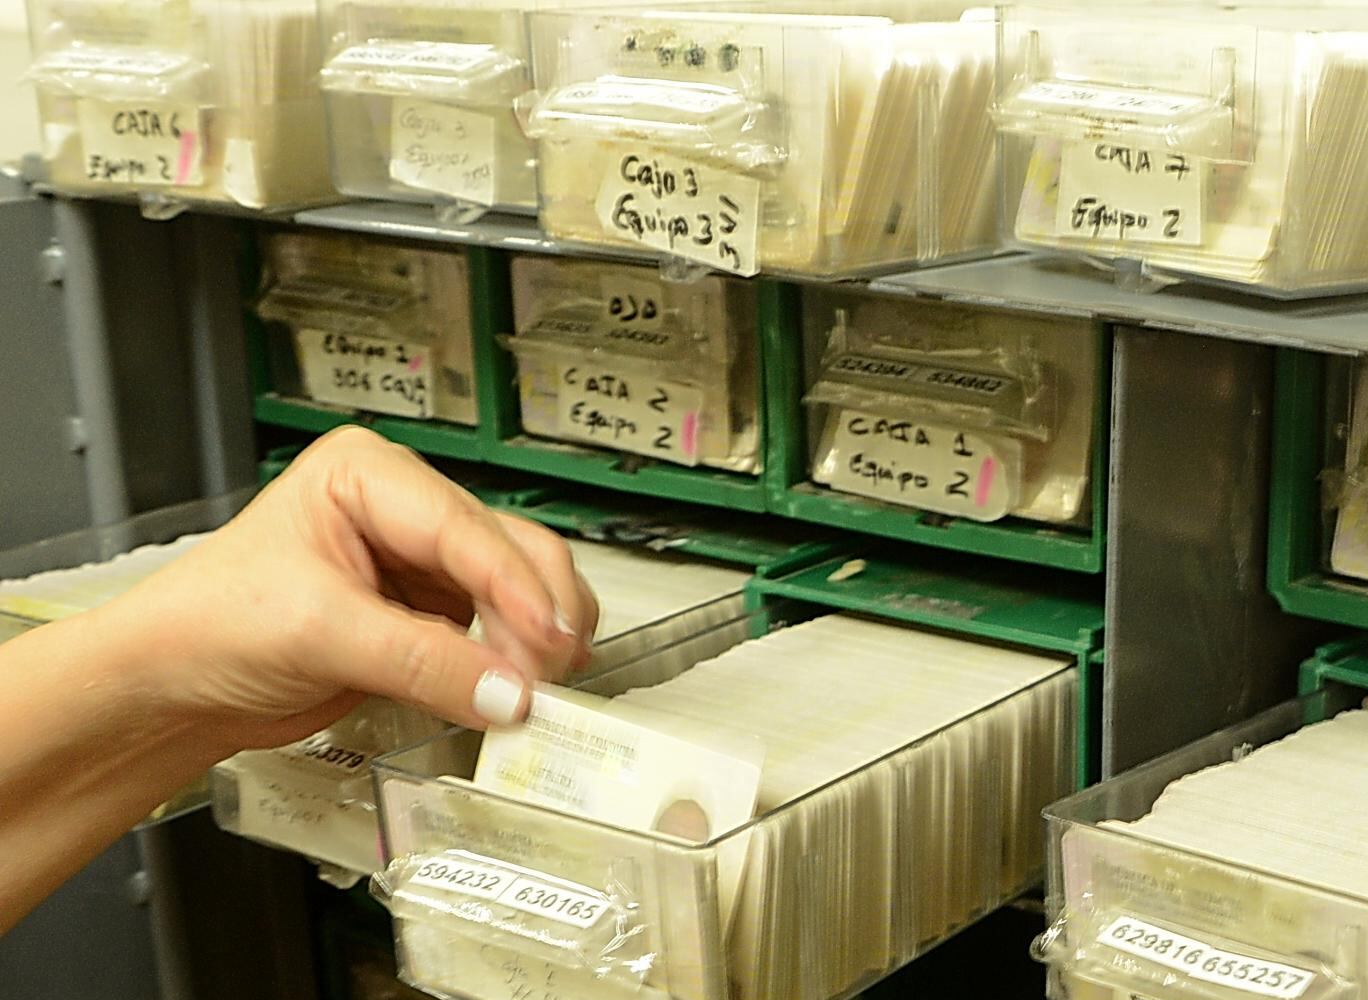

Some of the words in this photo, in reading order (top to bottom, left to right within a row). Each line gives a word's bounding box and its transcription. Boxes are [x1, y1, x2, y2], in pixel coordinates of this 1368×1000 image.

[112, 109, 164, 137] CAJA
[682, 167, 699, 197] 3
[1164, 153, 1190, 181] 7
[611, 193, 690, 249] Equipo
[693, 213, 713, 245] 3
[1071, 197, 1150, 241] Equipo
[1162, 208, 1181, 238] 2
[647, 388, 670, 413] 2
[568, 400, 637, 438] Equipo
[652, 425, 674, 451] 2
[953, 434, 974, 458] 1
[944, 470, 972, 499] 2
[415, 859, 503, 895] 594232
[513, 884, 600, 923] 630165
[1109, 922, 1204, 967] 629816
[1201, 956, 1307, 992] 655257
